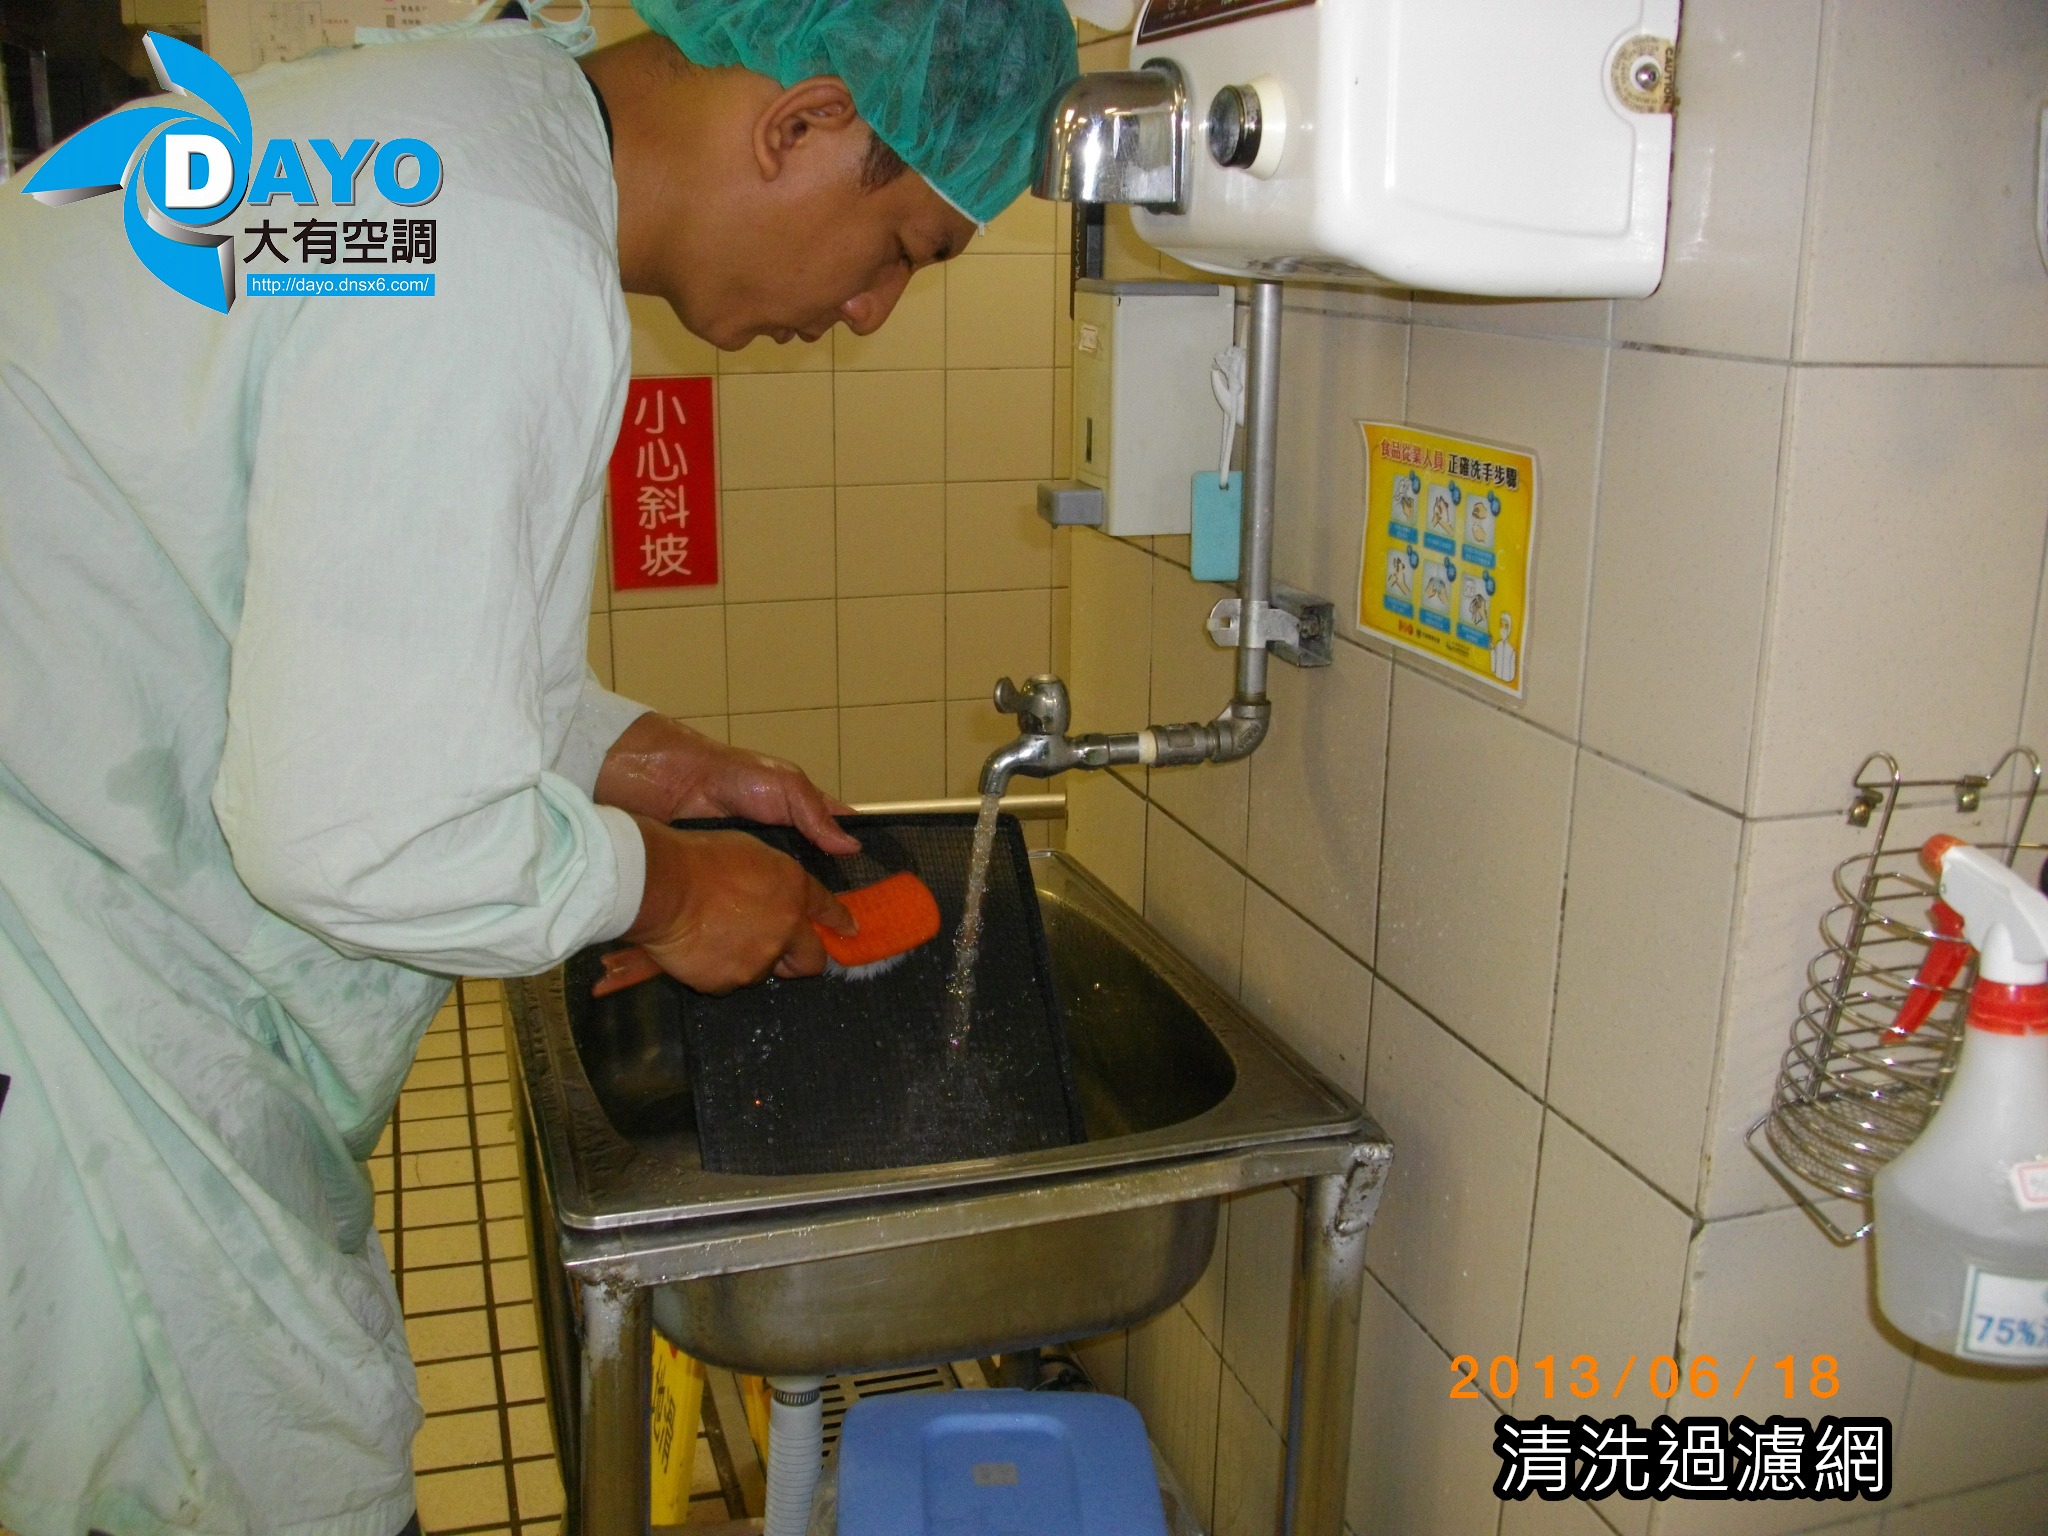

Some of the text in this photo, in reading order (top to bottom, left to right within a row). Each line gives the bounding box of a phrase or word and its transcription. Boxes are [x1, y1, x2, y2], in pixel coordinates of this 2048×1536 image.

[1664, 47, 1675, 104] CAUTION
[634, 389, 691, 577] 小心斜坡
[1447, 453, 1518, 488] 正確洗手步驟
